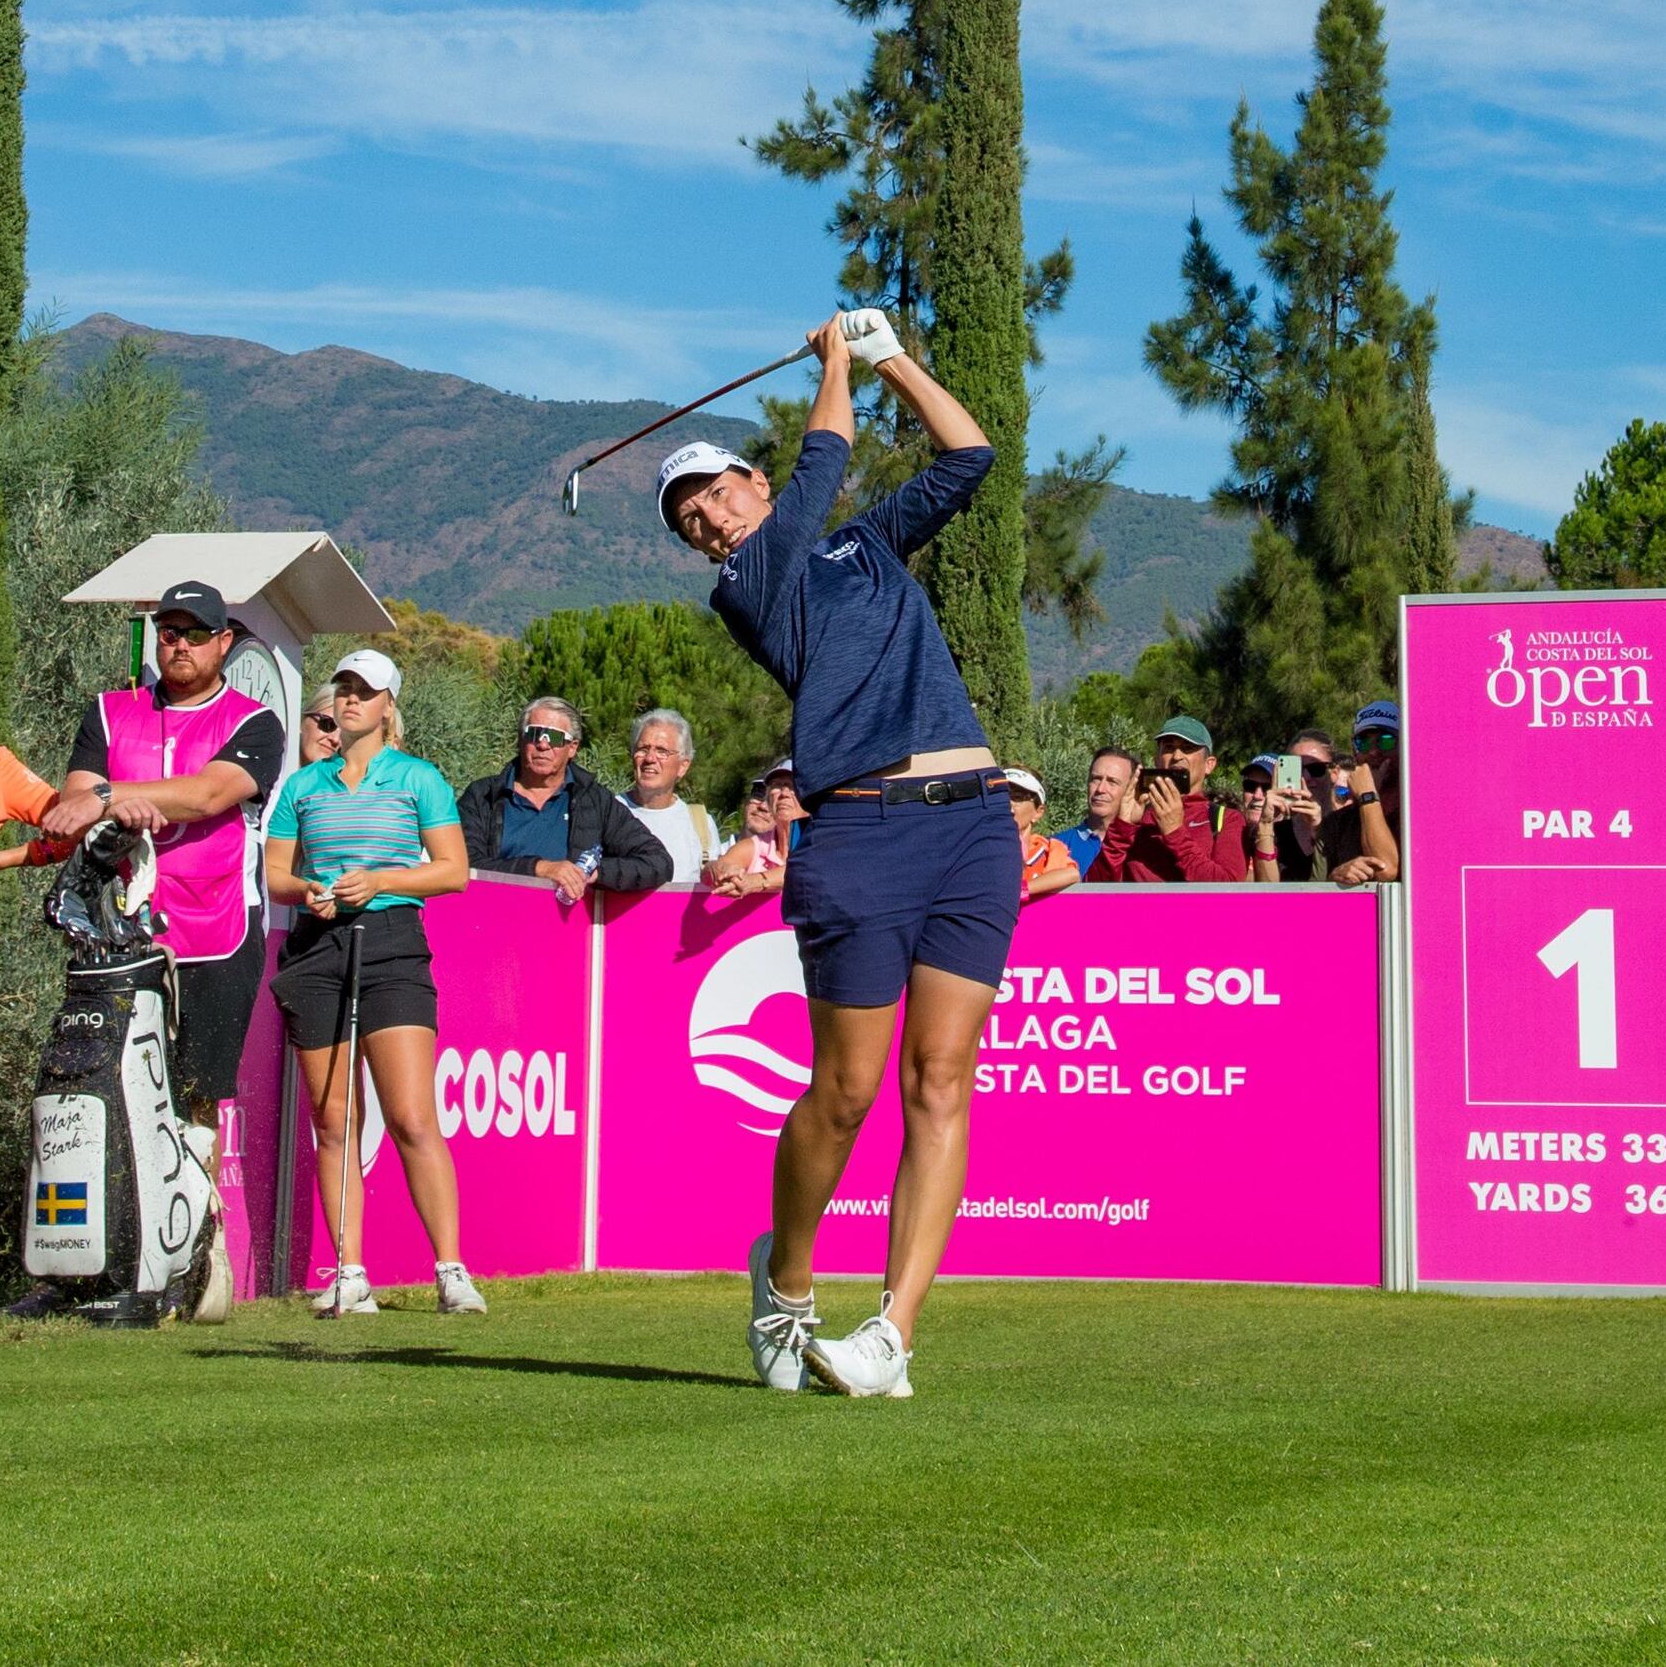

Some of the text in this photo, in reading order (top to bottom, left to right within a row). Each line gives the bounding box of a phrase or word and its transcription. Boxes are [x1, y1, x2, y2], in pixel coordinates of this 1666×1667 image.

[1526, 627, 1624, 645] ANDALUCÍA
[1526, 646, 1654, 662] COSTA DEL SOL
[1486, 665, 1654, 728] open
[1572, 708, 1654, 727] ESPAÑA
[1522, 809, 1633, 839] PAR 4
[993, 967, 1281, 1006] STA DEL SOL
[1536, 908, 1618, 1069] 1
[60, 1011, 105, 1032] ping
[979, 1014, 1117, 1050] LAGA
[434, 1047, 576, 1139] COSOL
[974, 1064, 1247, 1096] STA DEL GOLF
[40, 1110, 83, 1135] Maja
[41, 1132, 83, 1162] Stark
[132, 1031, 192, 1256] ping
[1466, 1131, 1607, 1162] METERS
[1468, 1182, 1592, 1213] YARDS
